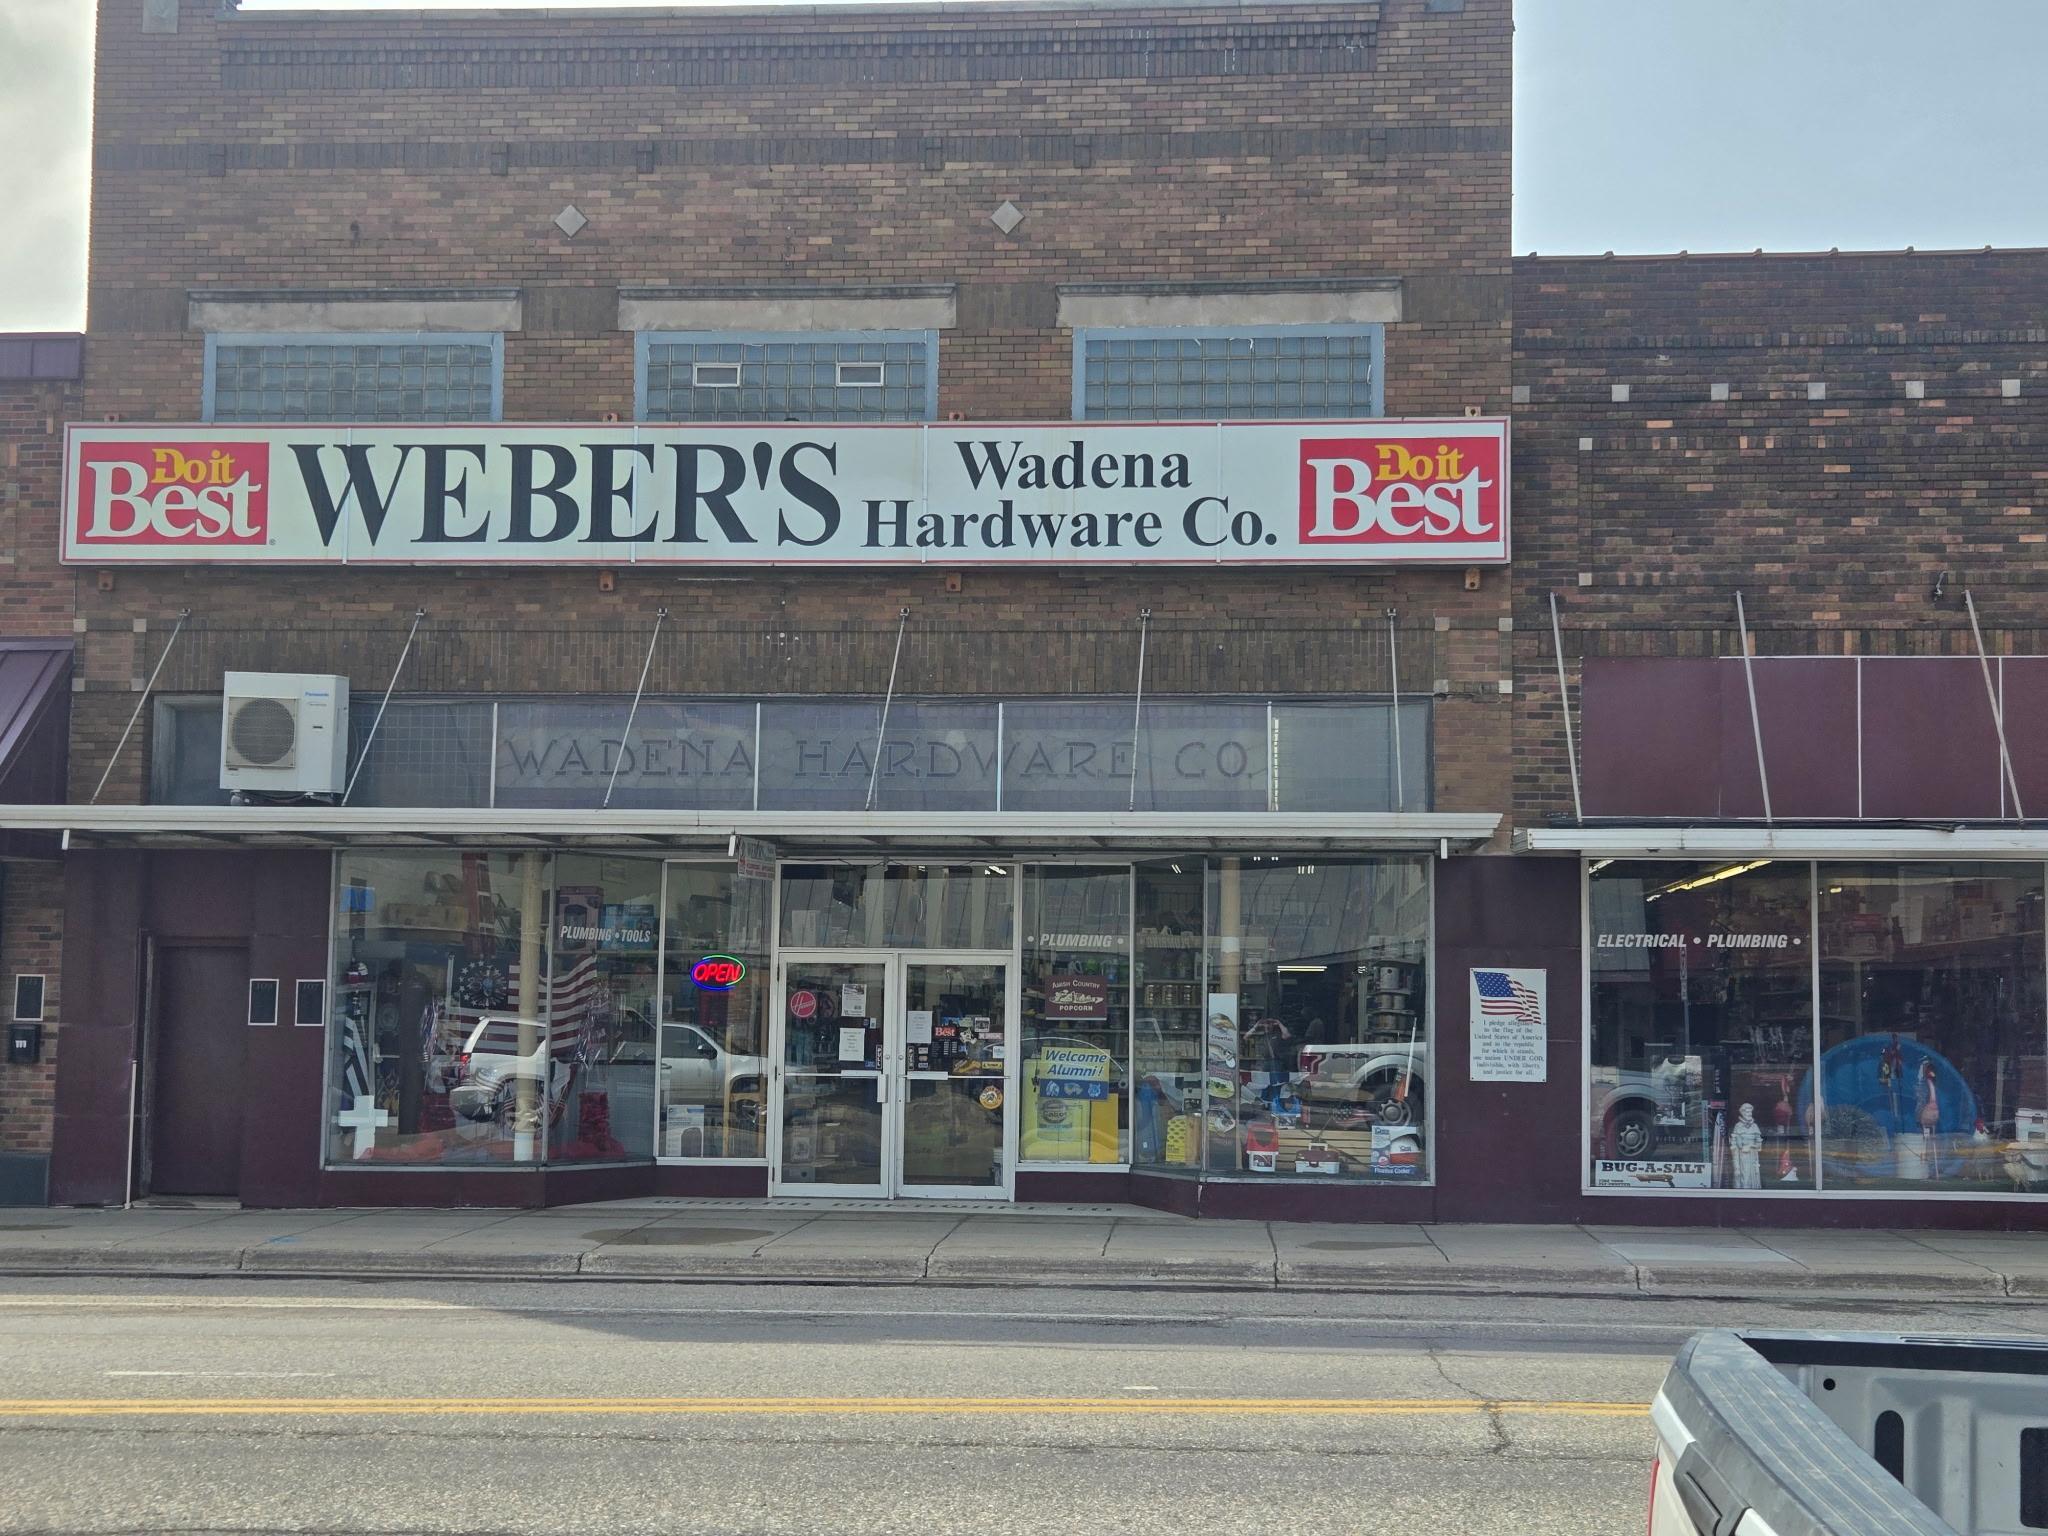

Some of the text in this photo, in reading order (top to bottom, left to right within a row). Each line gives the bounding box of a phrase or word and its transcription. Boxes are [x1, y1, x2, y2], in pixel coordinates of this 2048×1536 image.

[151, 448, 236, 485] Do it
[955, 440, 1193, 490] Wadena
[1374, 444, 1464, 480] Do it
[84, 461, 262, 538] Best
[288, 441, 841, 547] WEBER'S
[1306, 458, 1494, 537] Best
[861, 496, 1277, 548] Hardware Co.
[505, 739, 1253, 779] WADENA HARDWARE CO.
[560, 925, 651, 943] PLUMBING TOOLS
[1040, 933, 1112, 948] PLUMBING
[1597, 934, 1788, 948] ELECTRICAL PLUMBING
[693, 963, 741, 981] OPEN
[1045, 1050, 1107, 1063] Welcome
[1601, 1161, 1706, 1174] BUG-A-SALT
